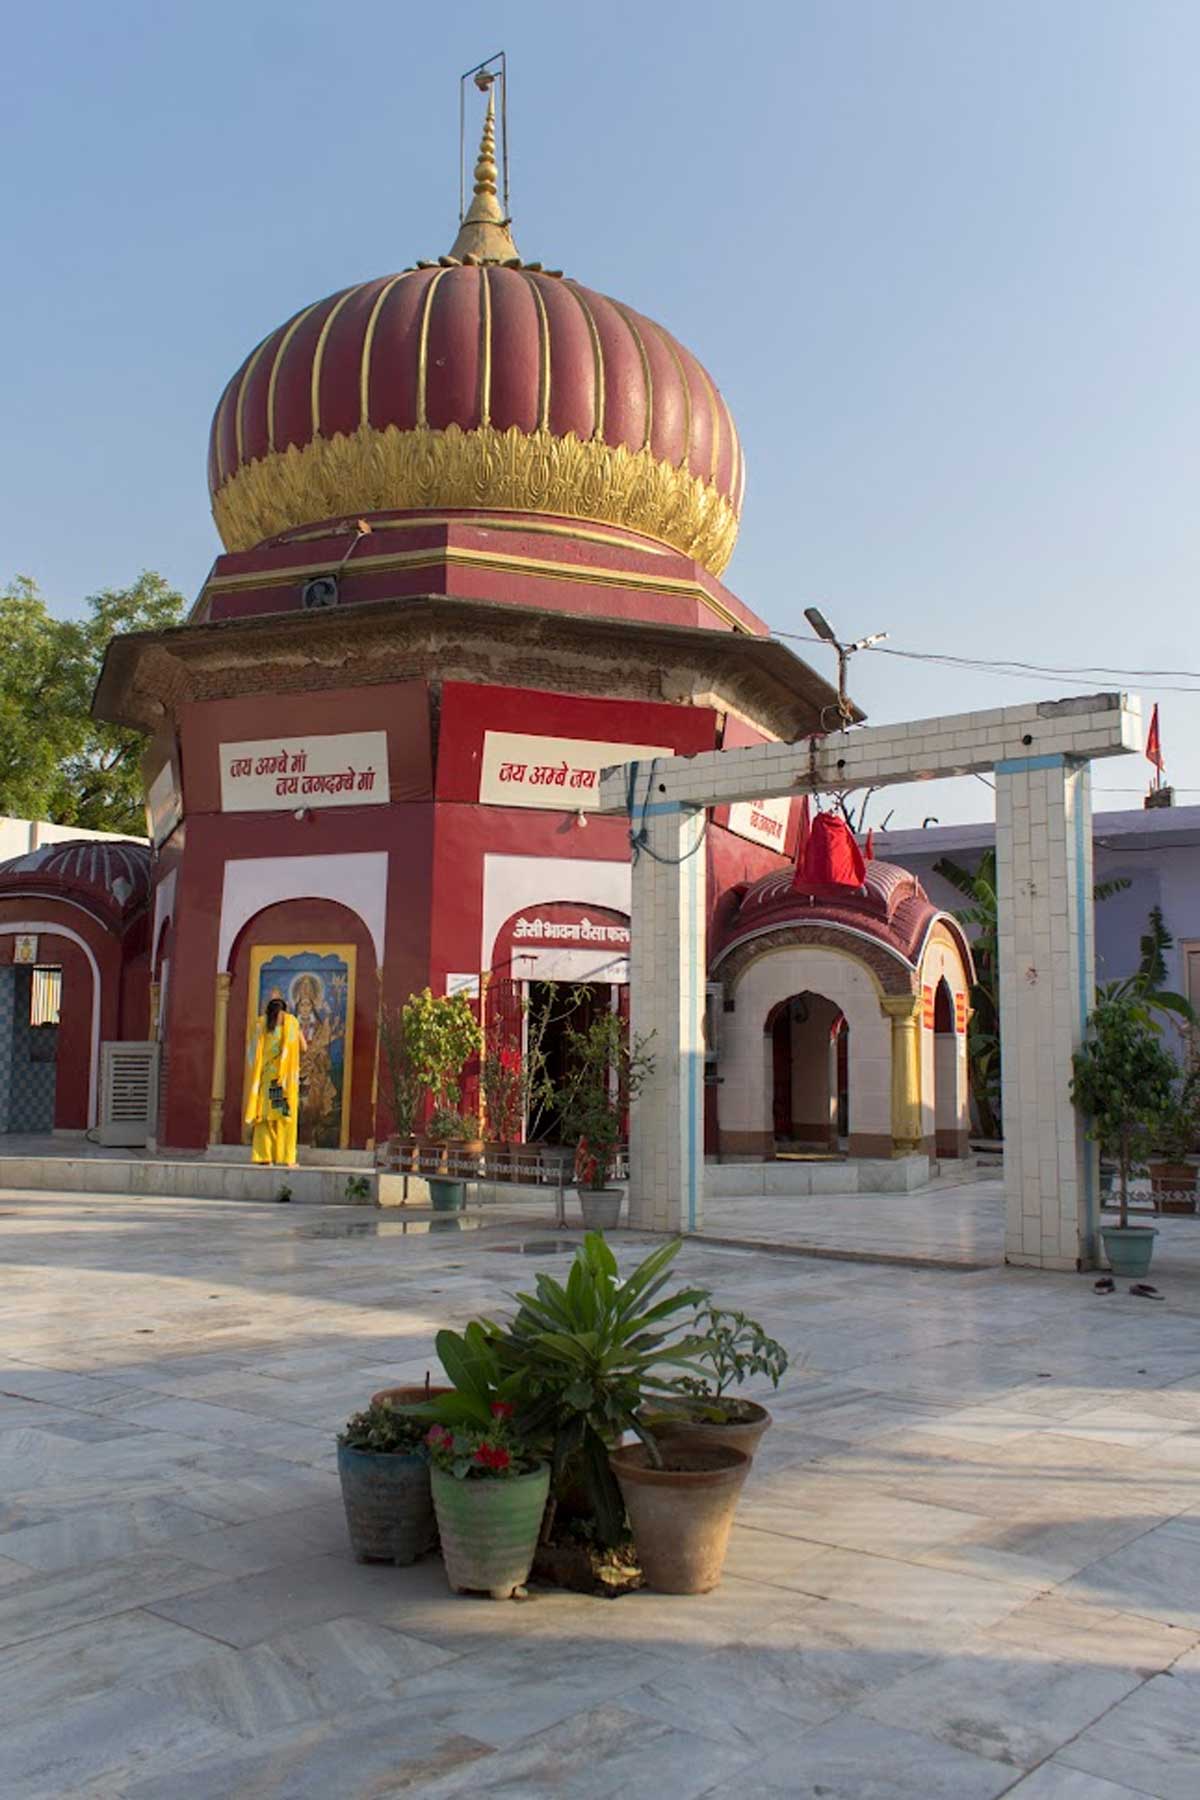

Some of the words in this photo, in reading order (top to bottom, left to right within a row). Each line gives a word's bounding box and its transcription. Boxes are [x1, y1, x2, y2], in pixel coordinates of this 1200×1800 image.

[230, 758, 253, 777] जय
[255, 750, 288, 775] अम्बे
[291, 750, 308, 772] मां
[499, 763, 527, 783] जय
[529, 761, 569, 786] अम्बे
[570, 769, 597, 788] जय
[276, 776, 299, 795] जय
[301, 767, 355, 794] जगदम्बे
[358, 767, 376, 790] मां
[513, 917, 543, 938] जैसी
[544, 921, 580, 940] भावना
[580, 917, 607, 941] वैसा
[607, 926, 631, 942] फल
